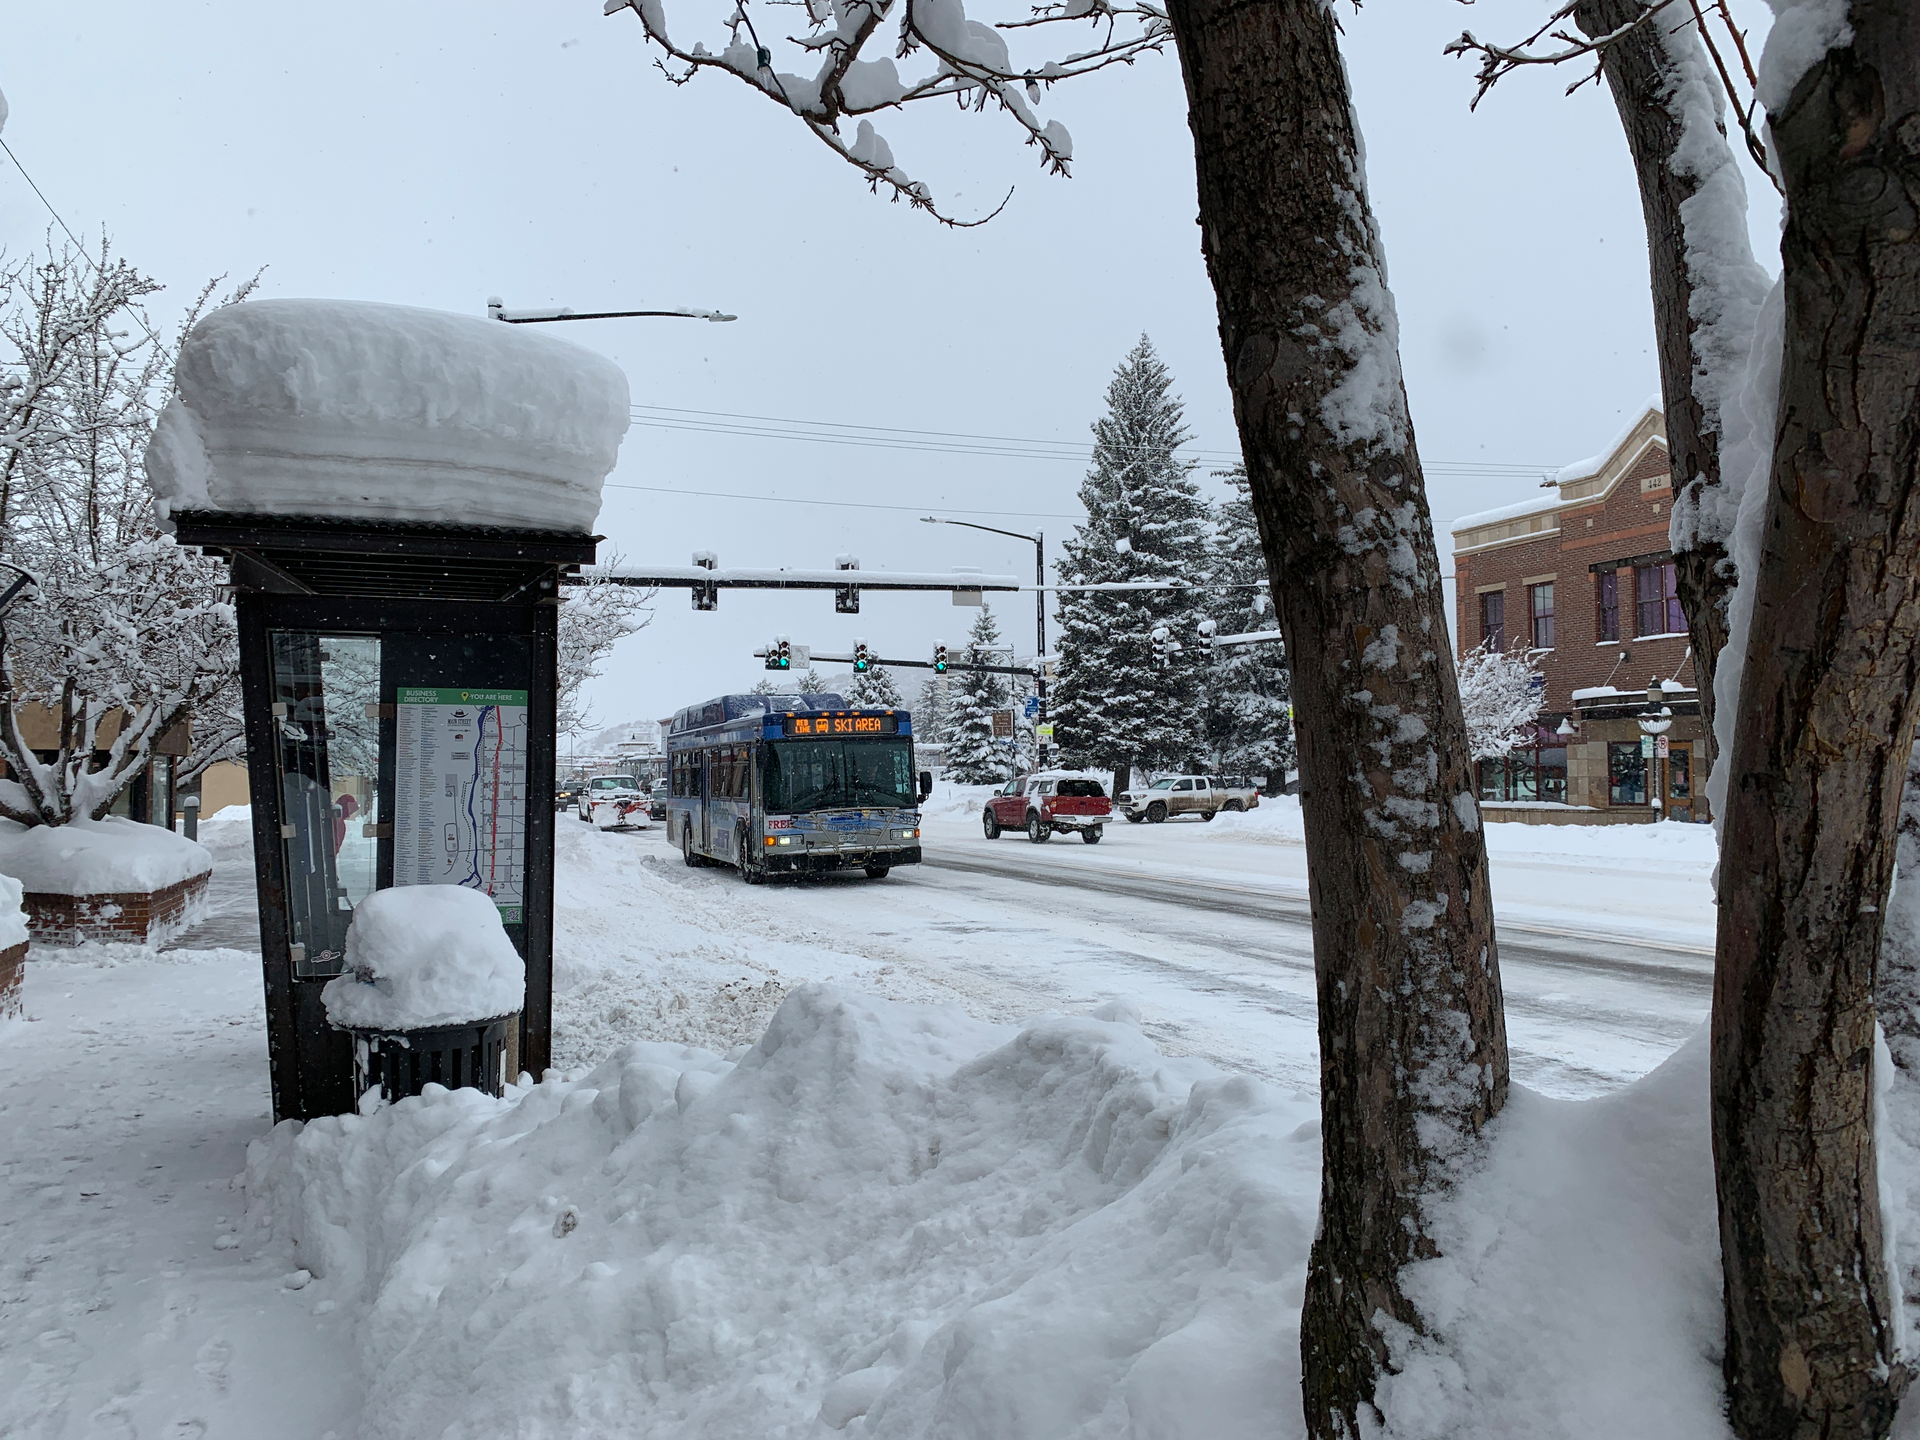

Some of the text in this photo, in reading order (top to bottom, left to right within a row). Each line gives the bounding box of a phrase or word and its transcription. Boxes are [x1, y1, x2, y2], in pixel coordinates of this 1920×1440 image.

[1647, 478, 1662, 489] 442
[795, 718, 809, 726] RED
[834, 718, 881, 732] SKI AREA
[795, 726, 811, 734] LINE
